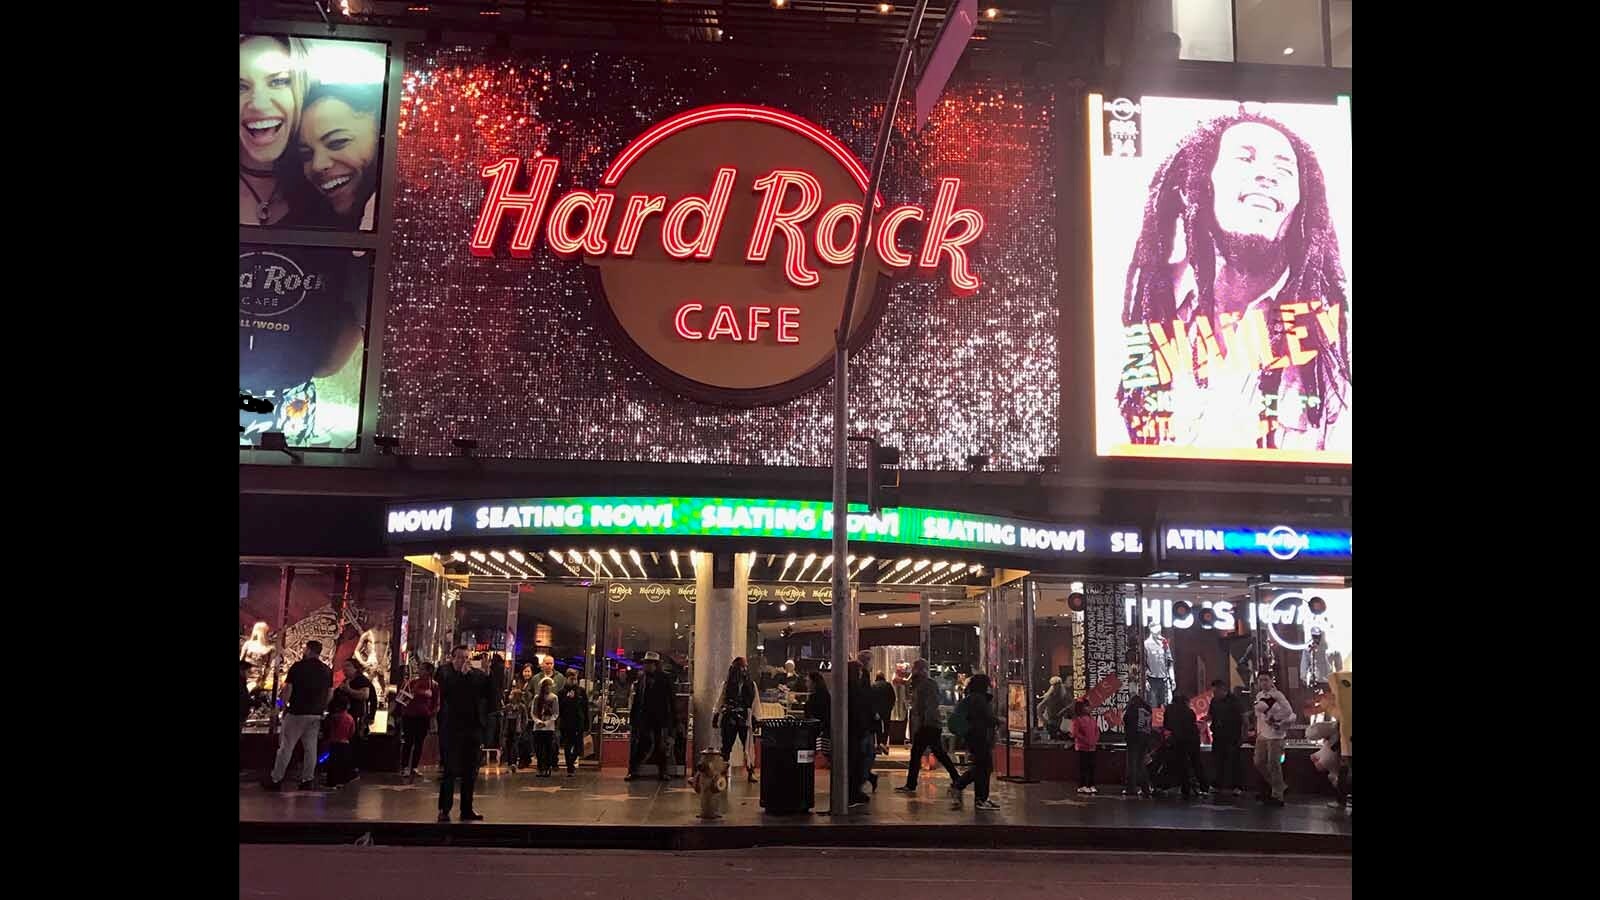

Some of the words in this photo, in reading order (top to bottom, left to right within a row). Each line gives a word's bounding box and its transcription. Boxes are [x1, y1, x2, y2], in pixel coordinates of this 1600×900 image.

[470, 157, 739, 260] Hard
[746, 168, 985, 294] Rock
[674, 302, 801, 344] CAFE
[387, 506, 454, 533] NOW!
[475, 504, 584, 529] SEATING
[590, 504, 674, 529] NOW!
[701, 504, 816, 532] SEATING
[922, 516, 1016, 546] SEATING
[1020, 526, 1086, 552] NOW!
[1166, 528, 1225, 551] ATIN
